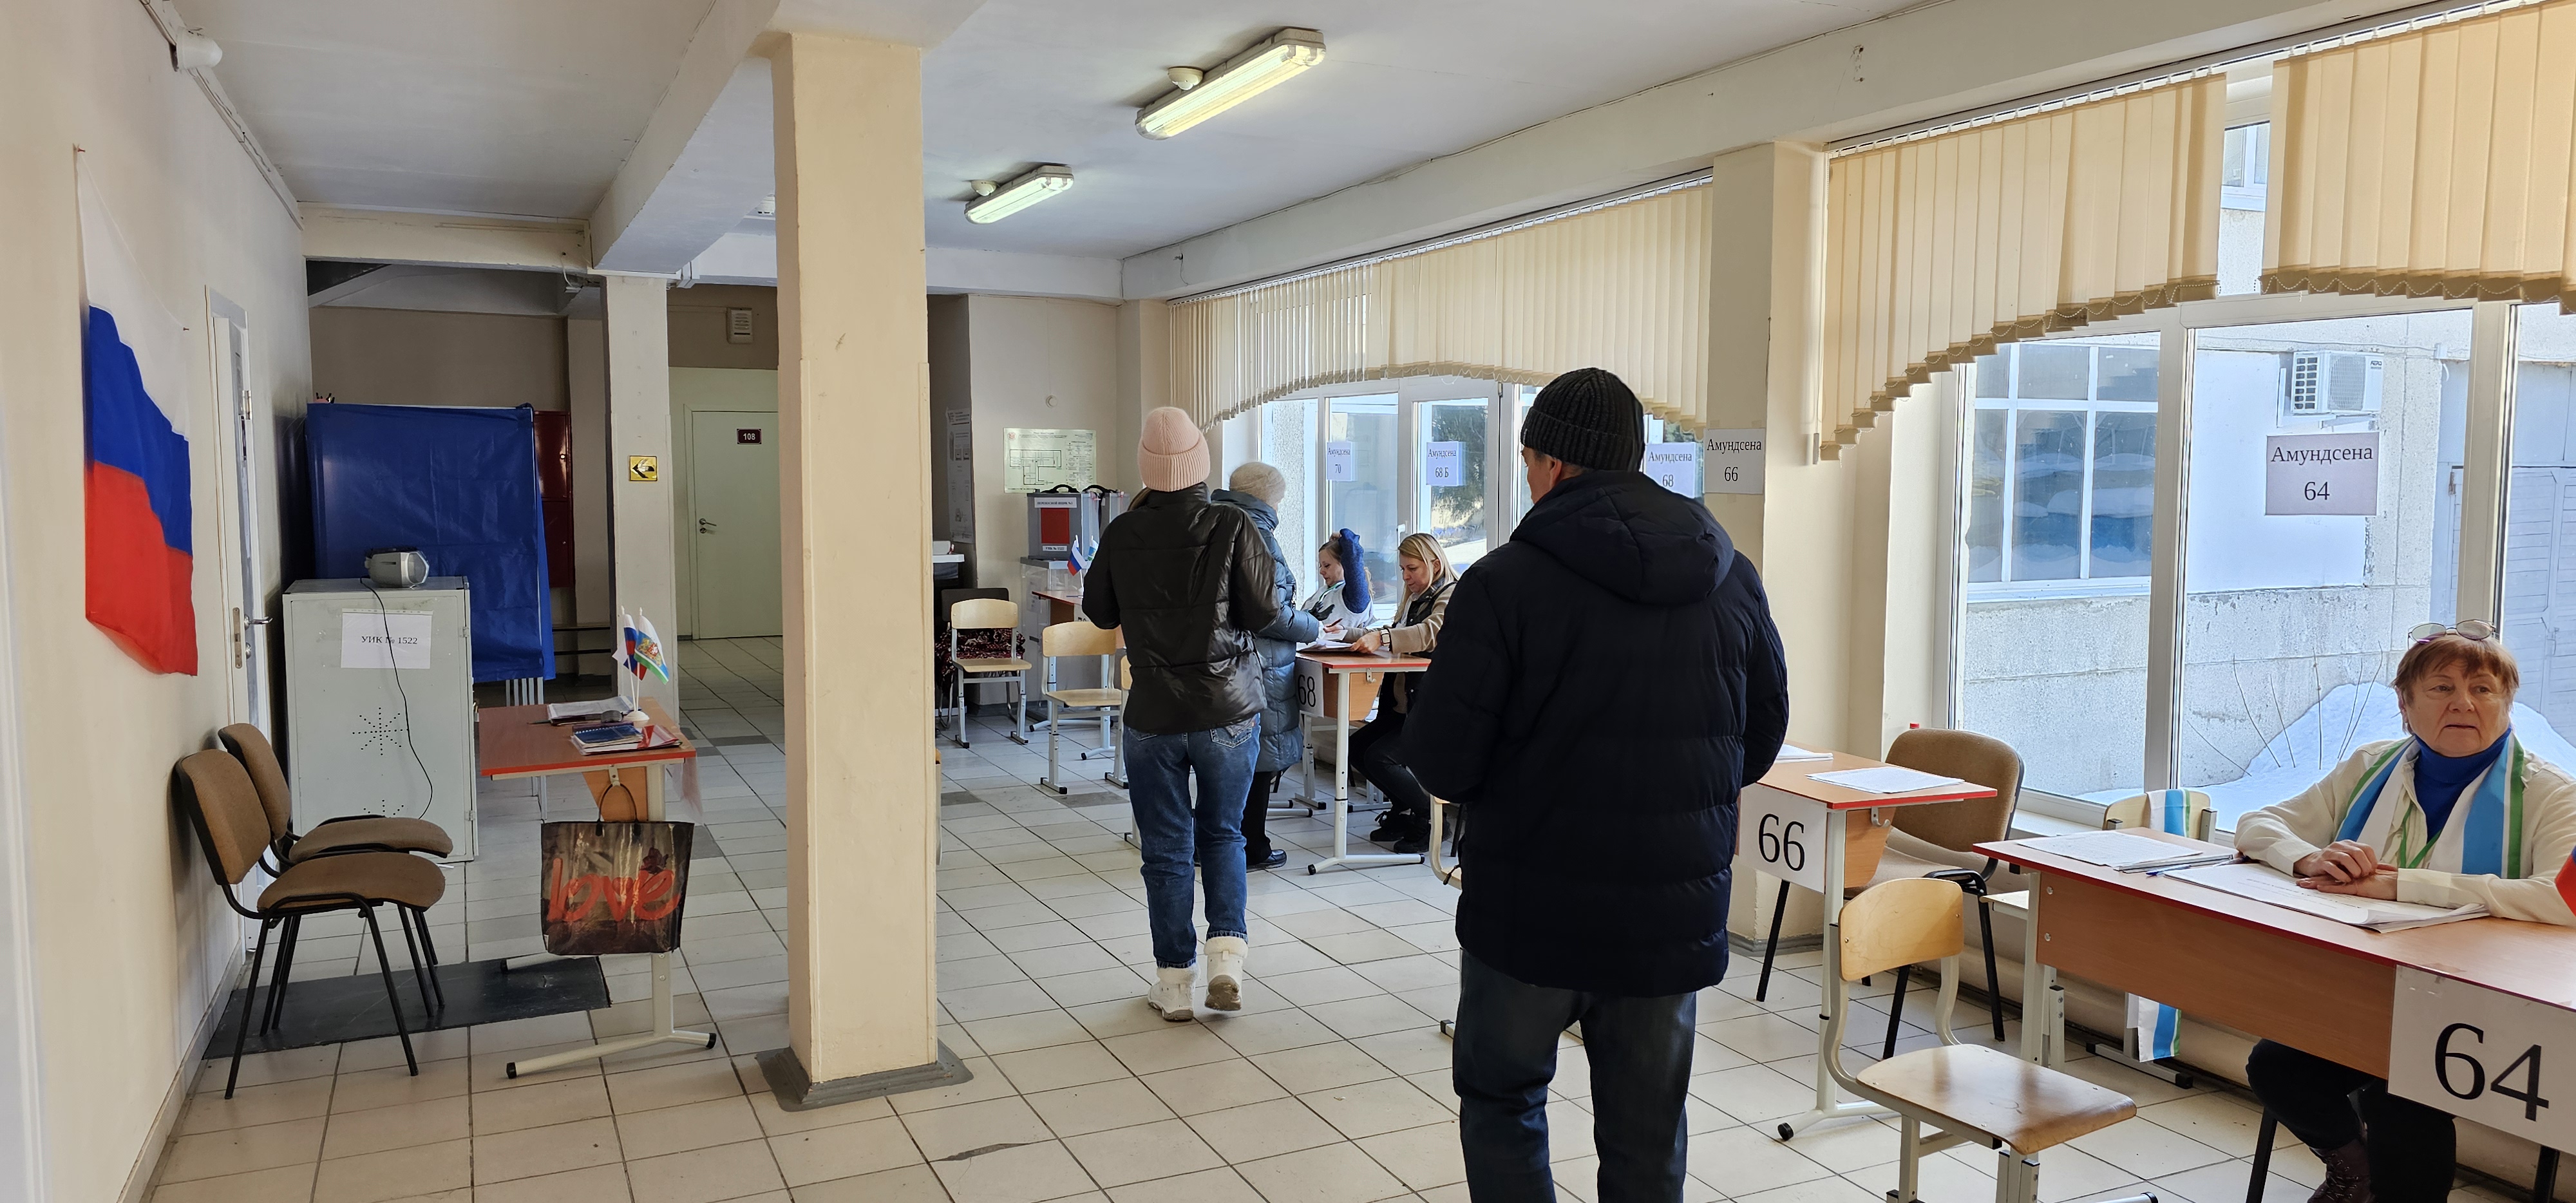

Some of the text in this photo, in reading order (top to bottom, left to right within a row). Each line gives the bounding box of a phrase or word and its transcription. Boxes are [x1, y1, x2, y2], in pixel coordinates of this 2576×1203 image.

[1327, 448, 1350, 457] Амундсена
[1428, 448, 1457, 459] Амундсена
[1707, 439, 1761, 454] Амундсена
[1648, 451, 1692, 464] Амундсена
[2271, 446, 2373, 466] Амундсена
[1334, 464, 1342, 473] 70
[1435, 467, 1449, 478] 68 Б
[1724, 466, 1738, 482] 66
[1662, 474, 1674, 487] 68
[2304, 481, 2330, 500] 64
[1297, 674, 1316, 707] 68
[1758, 813, 1805, 871] 66
[547, 857, 681, 922] love
[2435, 1023, 2549, 1122] 64
